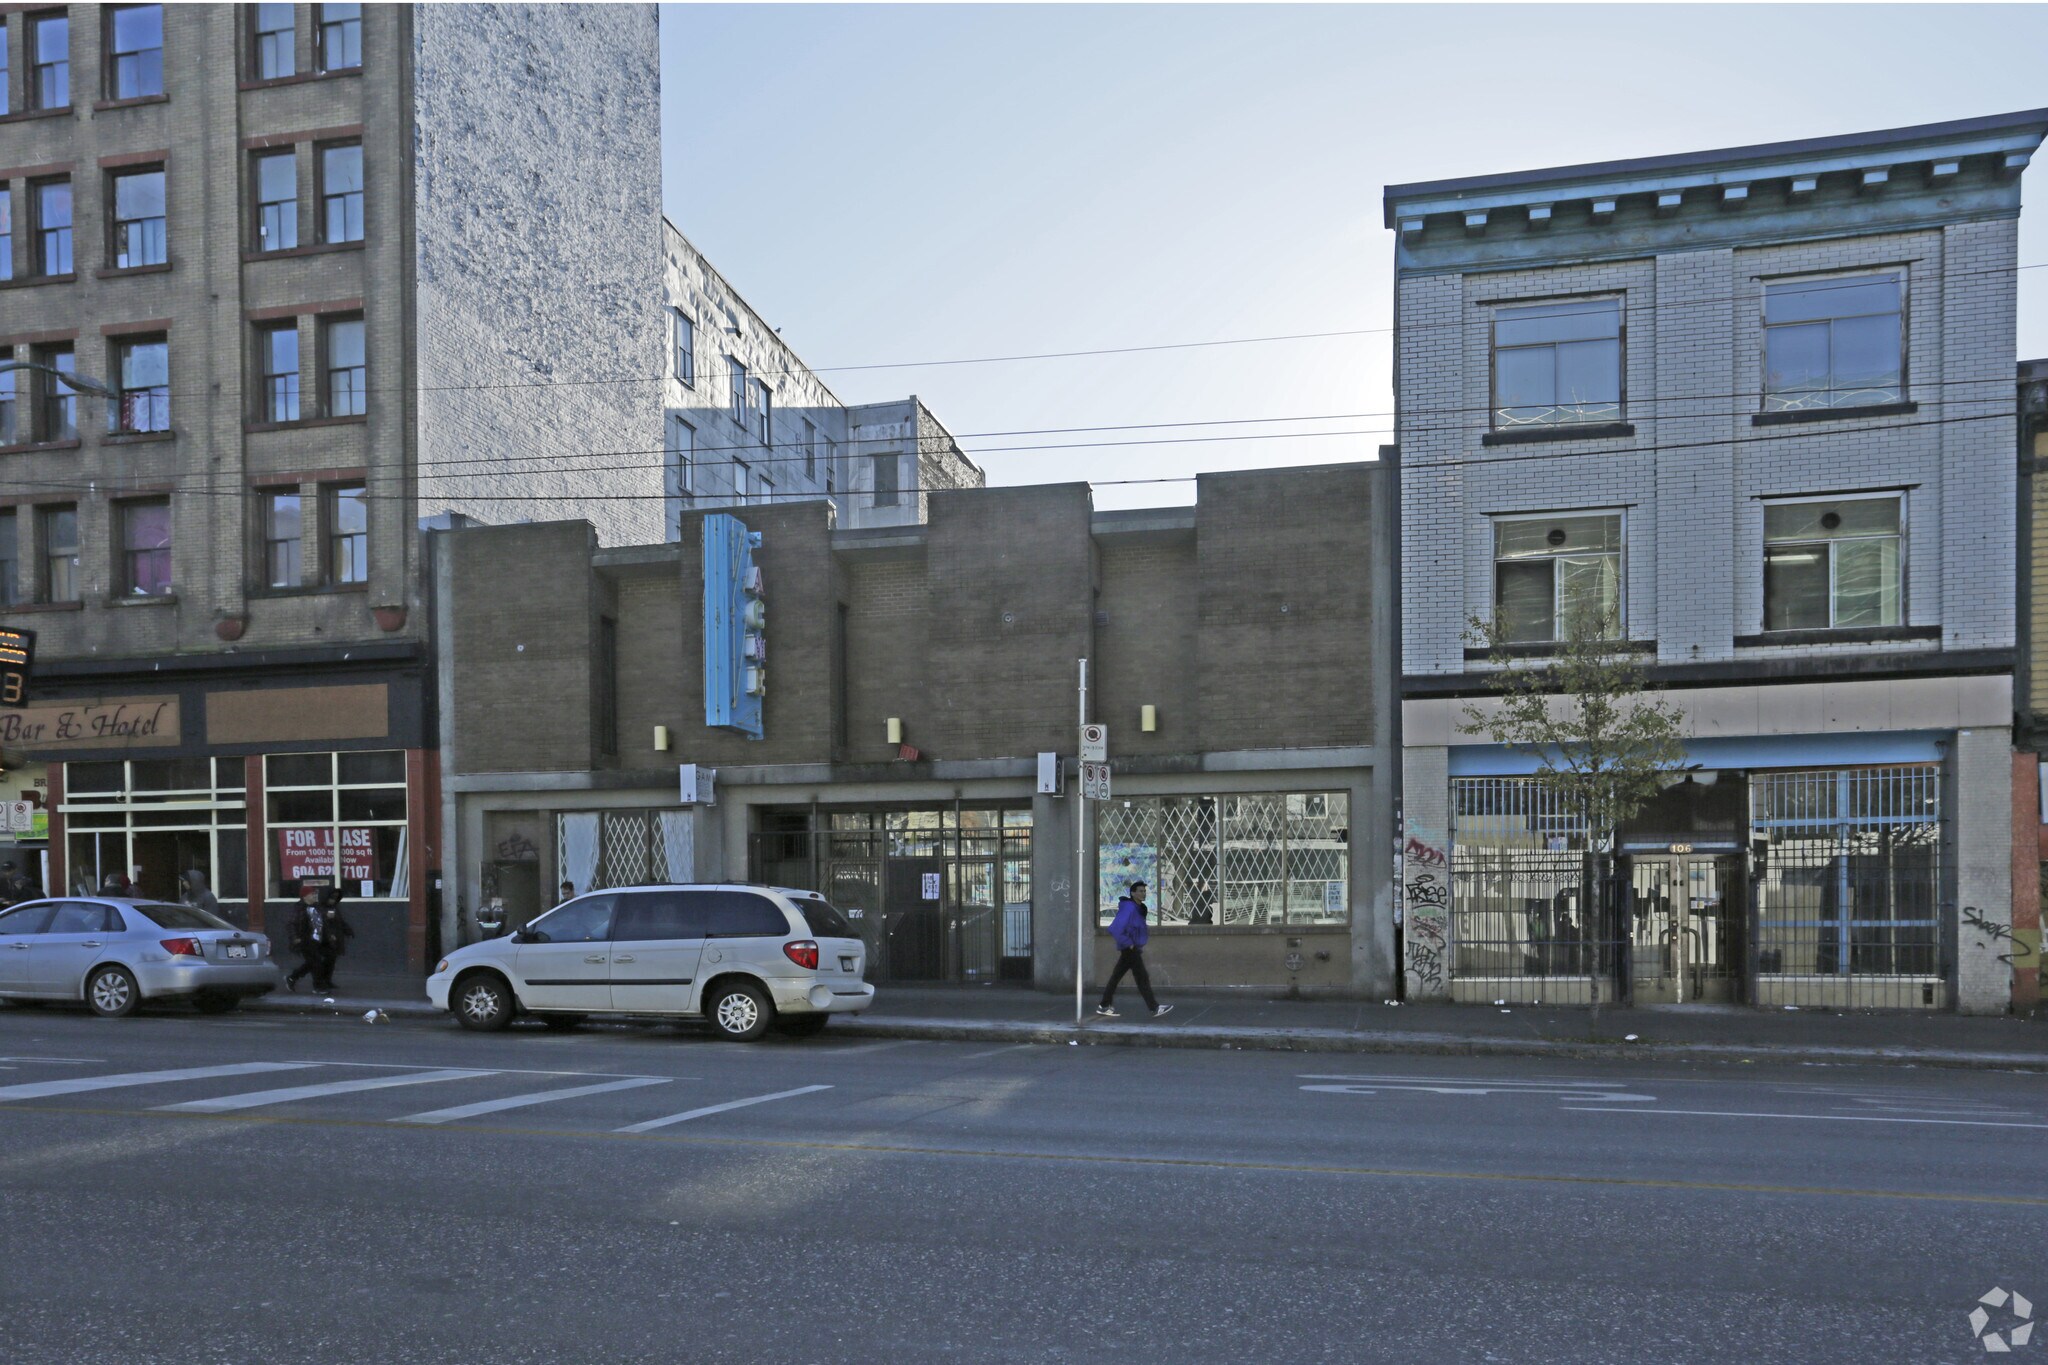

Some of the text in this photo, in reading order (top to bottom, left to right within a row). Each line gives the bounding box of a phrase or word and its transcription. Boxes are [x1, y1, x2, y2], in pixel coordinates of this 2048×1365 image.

[3, 672, 23, 702] 3
[0, 714, 45, 741] Bar
[91, 703, 167, 736] Hotel
[286, 829, 371, 847] FOR LASE
[1672, 844, 1692, 853] 106
[293, 866, 315, 878] 604
[343, 866, 369, 878] 7107
